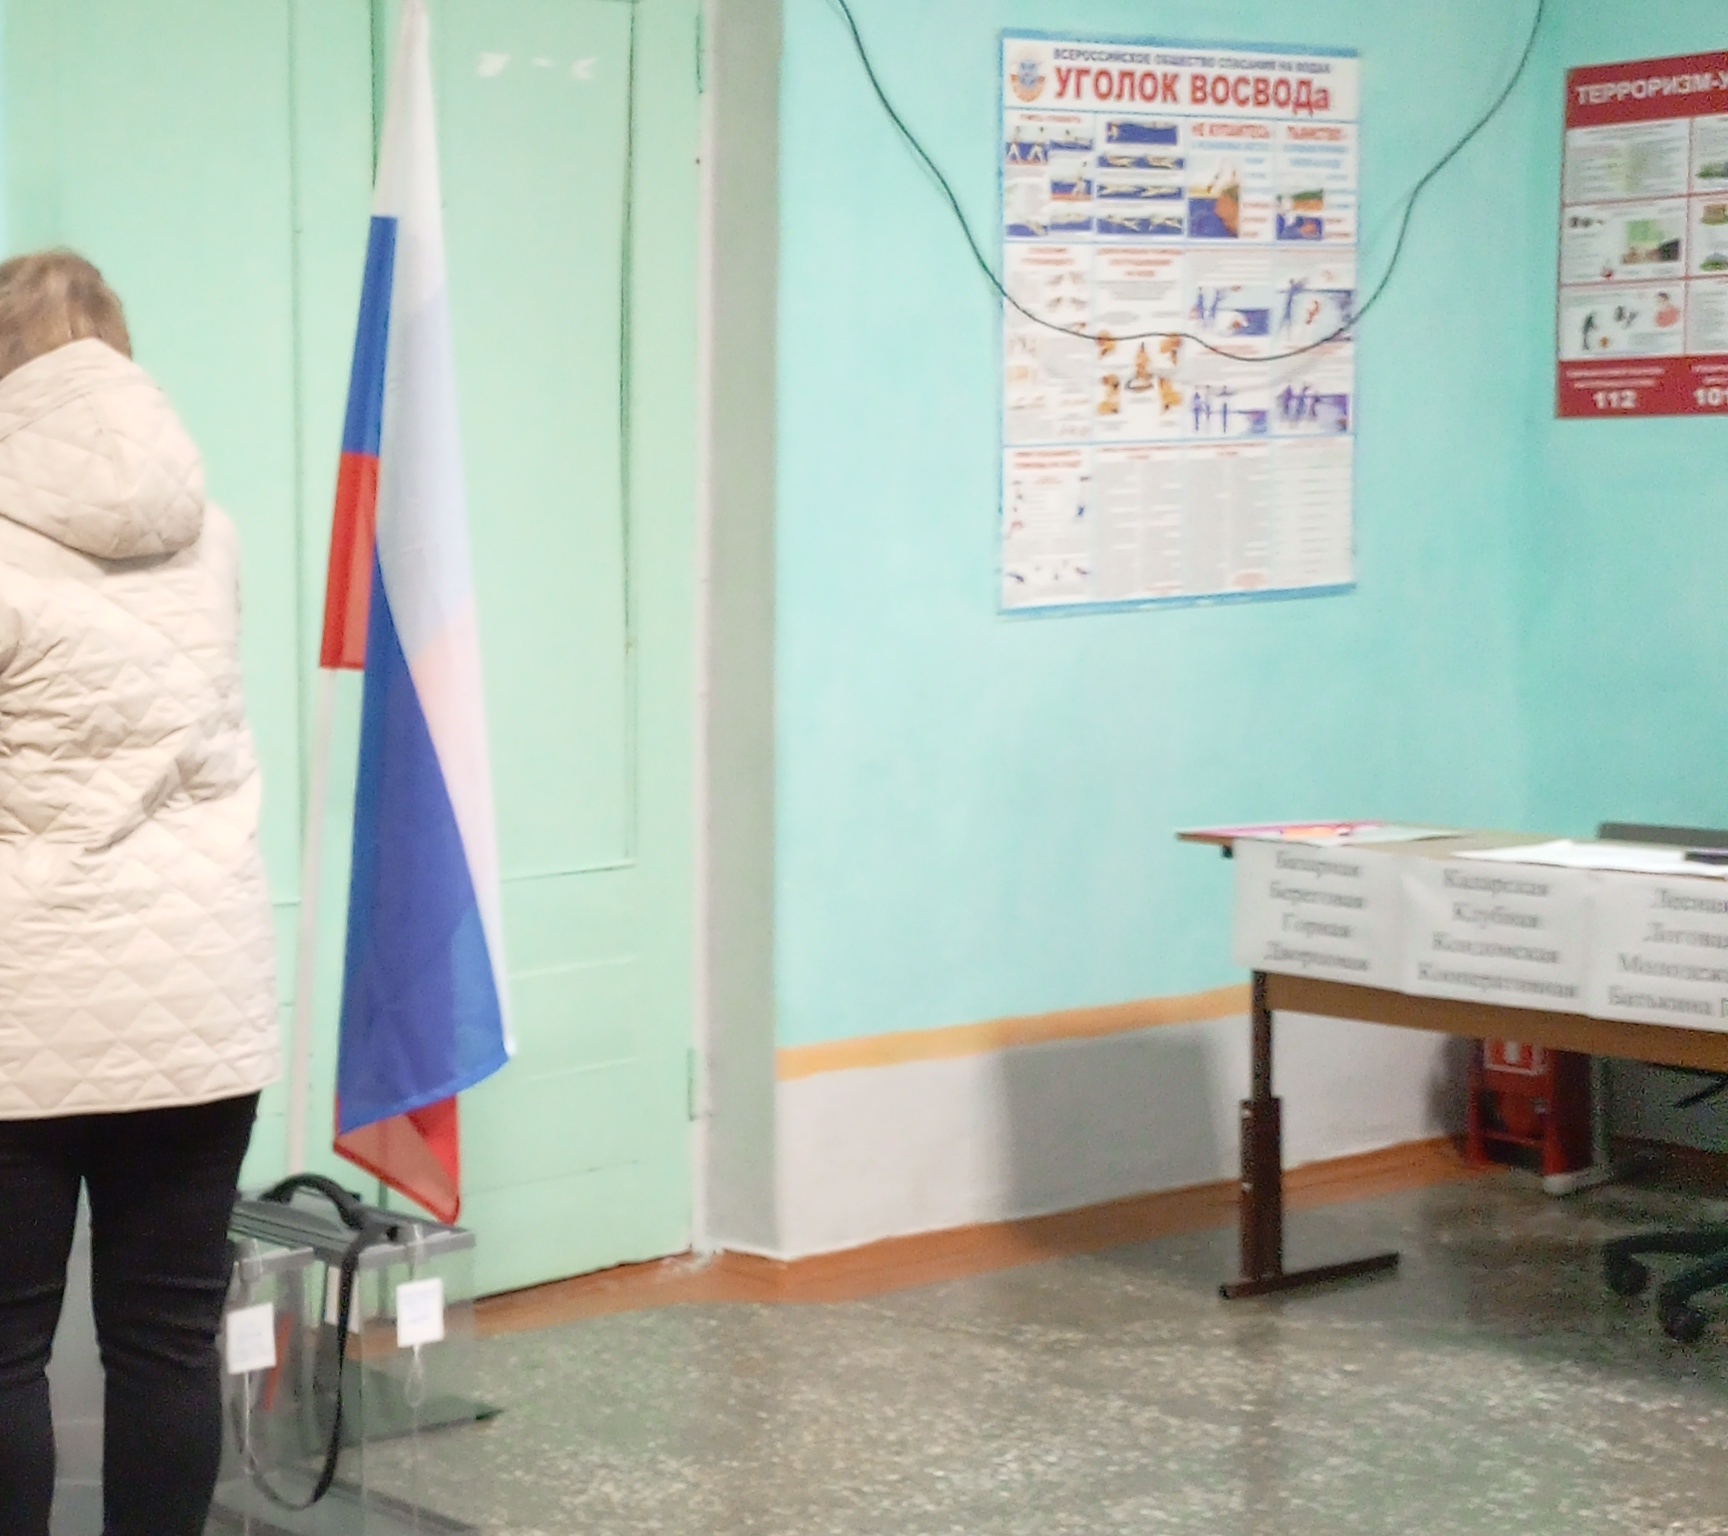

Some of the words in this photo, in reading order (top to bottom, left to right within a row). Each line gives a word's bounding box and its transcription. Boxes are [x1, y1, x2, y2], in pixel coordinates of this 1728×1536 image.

[1055, 66, 1180, 104] УГОЛОК
[1190, 73, 1331, 117] ВОСВОДа
[1592, 389, 1637, 410] 112
